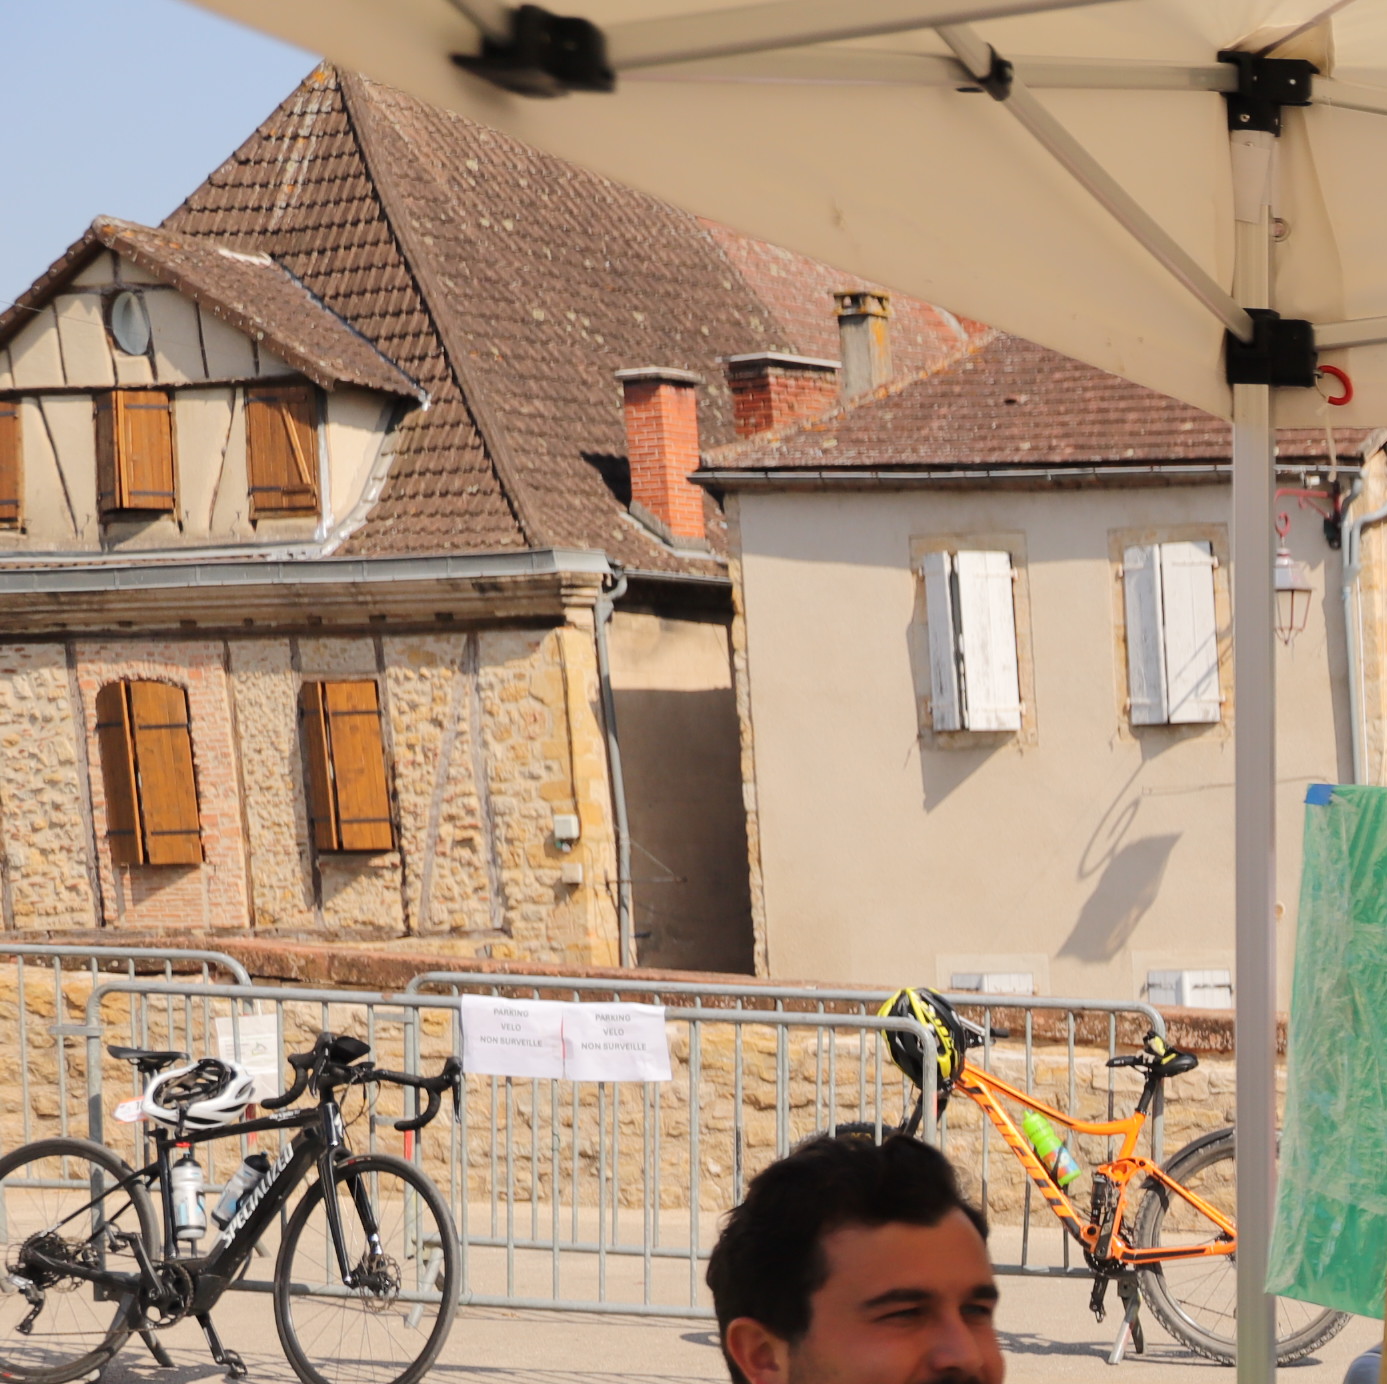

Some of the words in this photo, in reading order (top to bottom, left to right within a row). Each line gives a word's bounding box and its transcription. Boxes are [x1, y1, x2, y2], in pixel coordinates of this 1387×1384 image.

[493, 1007, 529, 1018] PARKING
[595, 1013, 631, 1023] PARKING
[501, 1022, 522, 1032] VELO
[603, 1027, 625, 1037] VELO
[480, 1035, 499, 1045] NON
[500, 1036, 543, 1048] SURVEILLE
[581, 1042, 601, 1051] NON
[603, 1042, 647, 1052] SURVEILLE
[221, 1142, 295, 1249] SPECIALIZED
